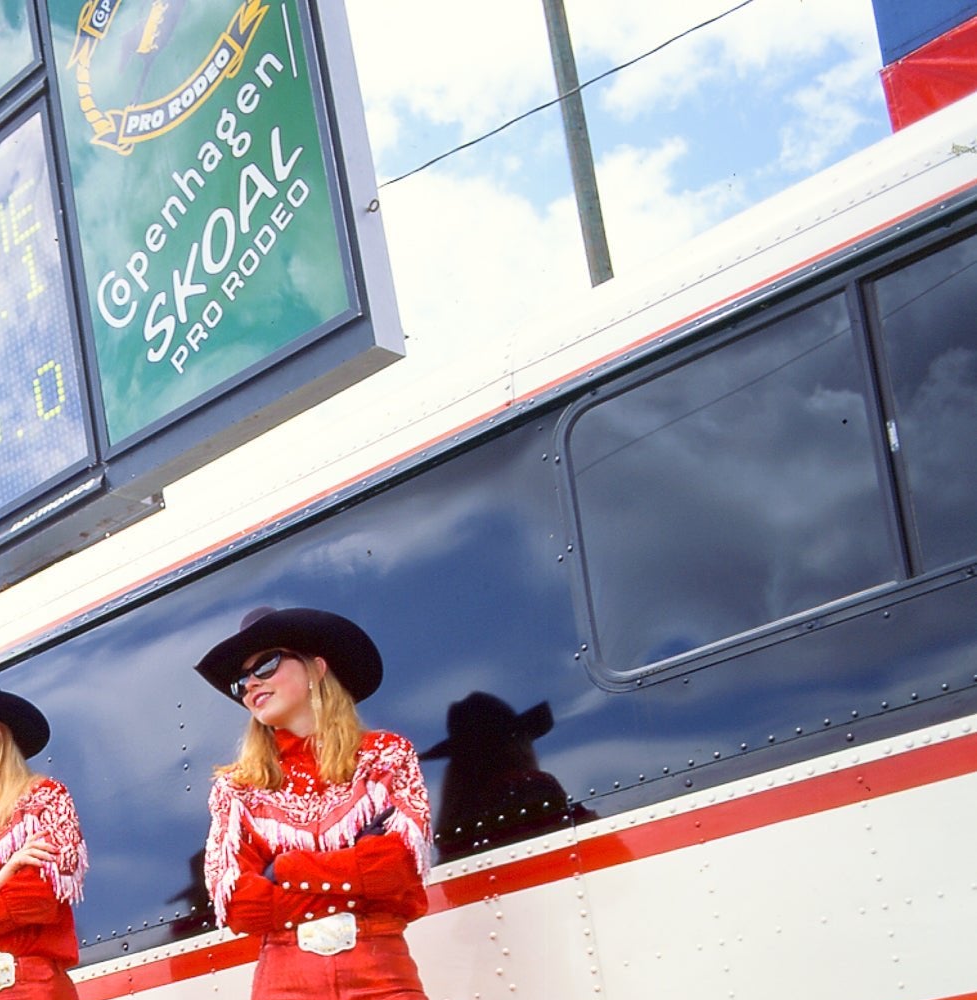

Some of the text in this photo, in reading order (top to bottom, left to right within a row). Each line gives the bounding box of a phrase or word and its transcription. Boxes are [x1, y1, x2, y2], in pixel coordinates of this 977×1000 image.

[98, 52, 283, 328] Copenhagen
[126, 48, 230, 133] PRO RODEO
[143, 127, 303, 363] SKOAL
[170, 178, 310, 374] PRO RODEO
